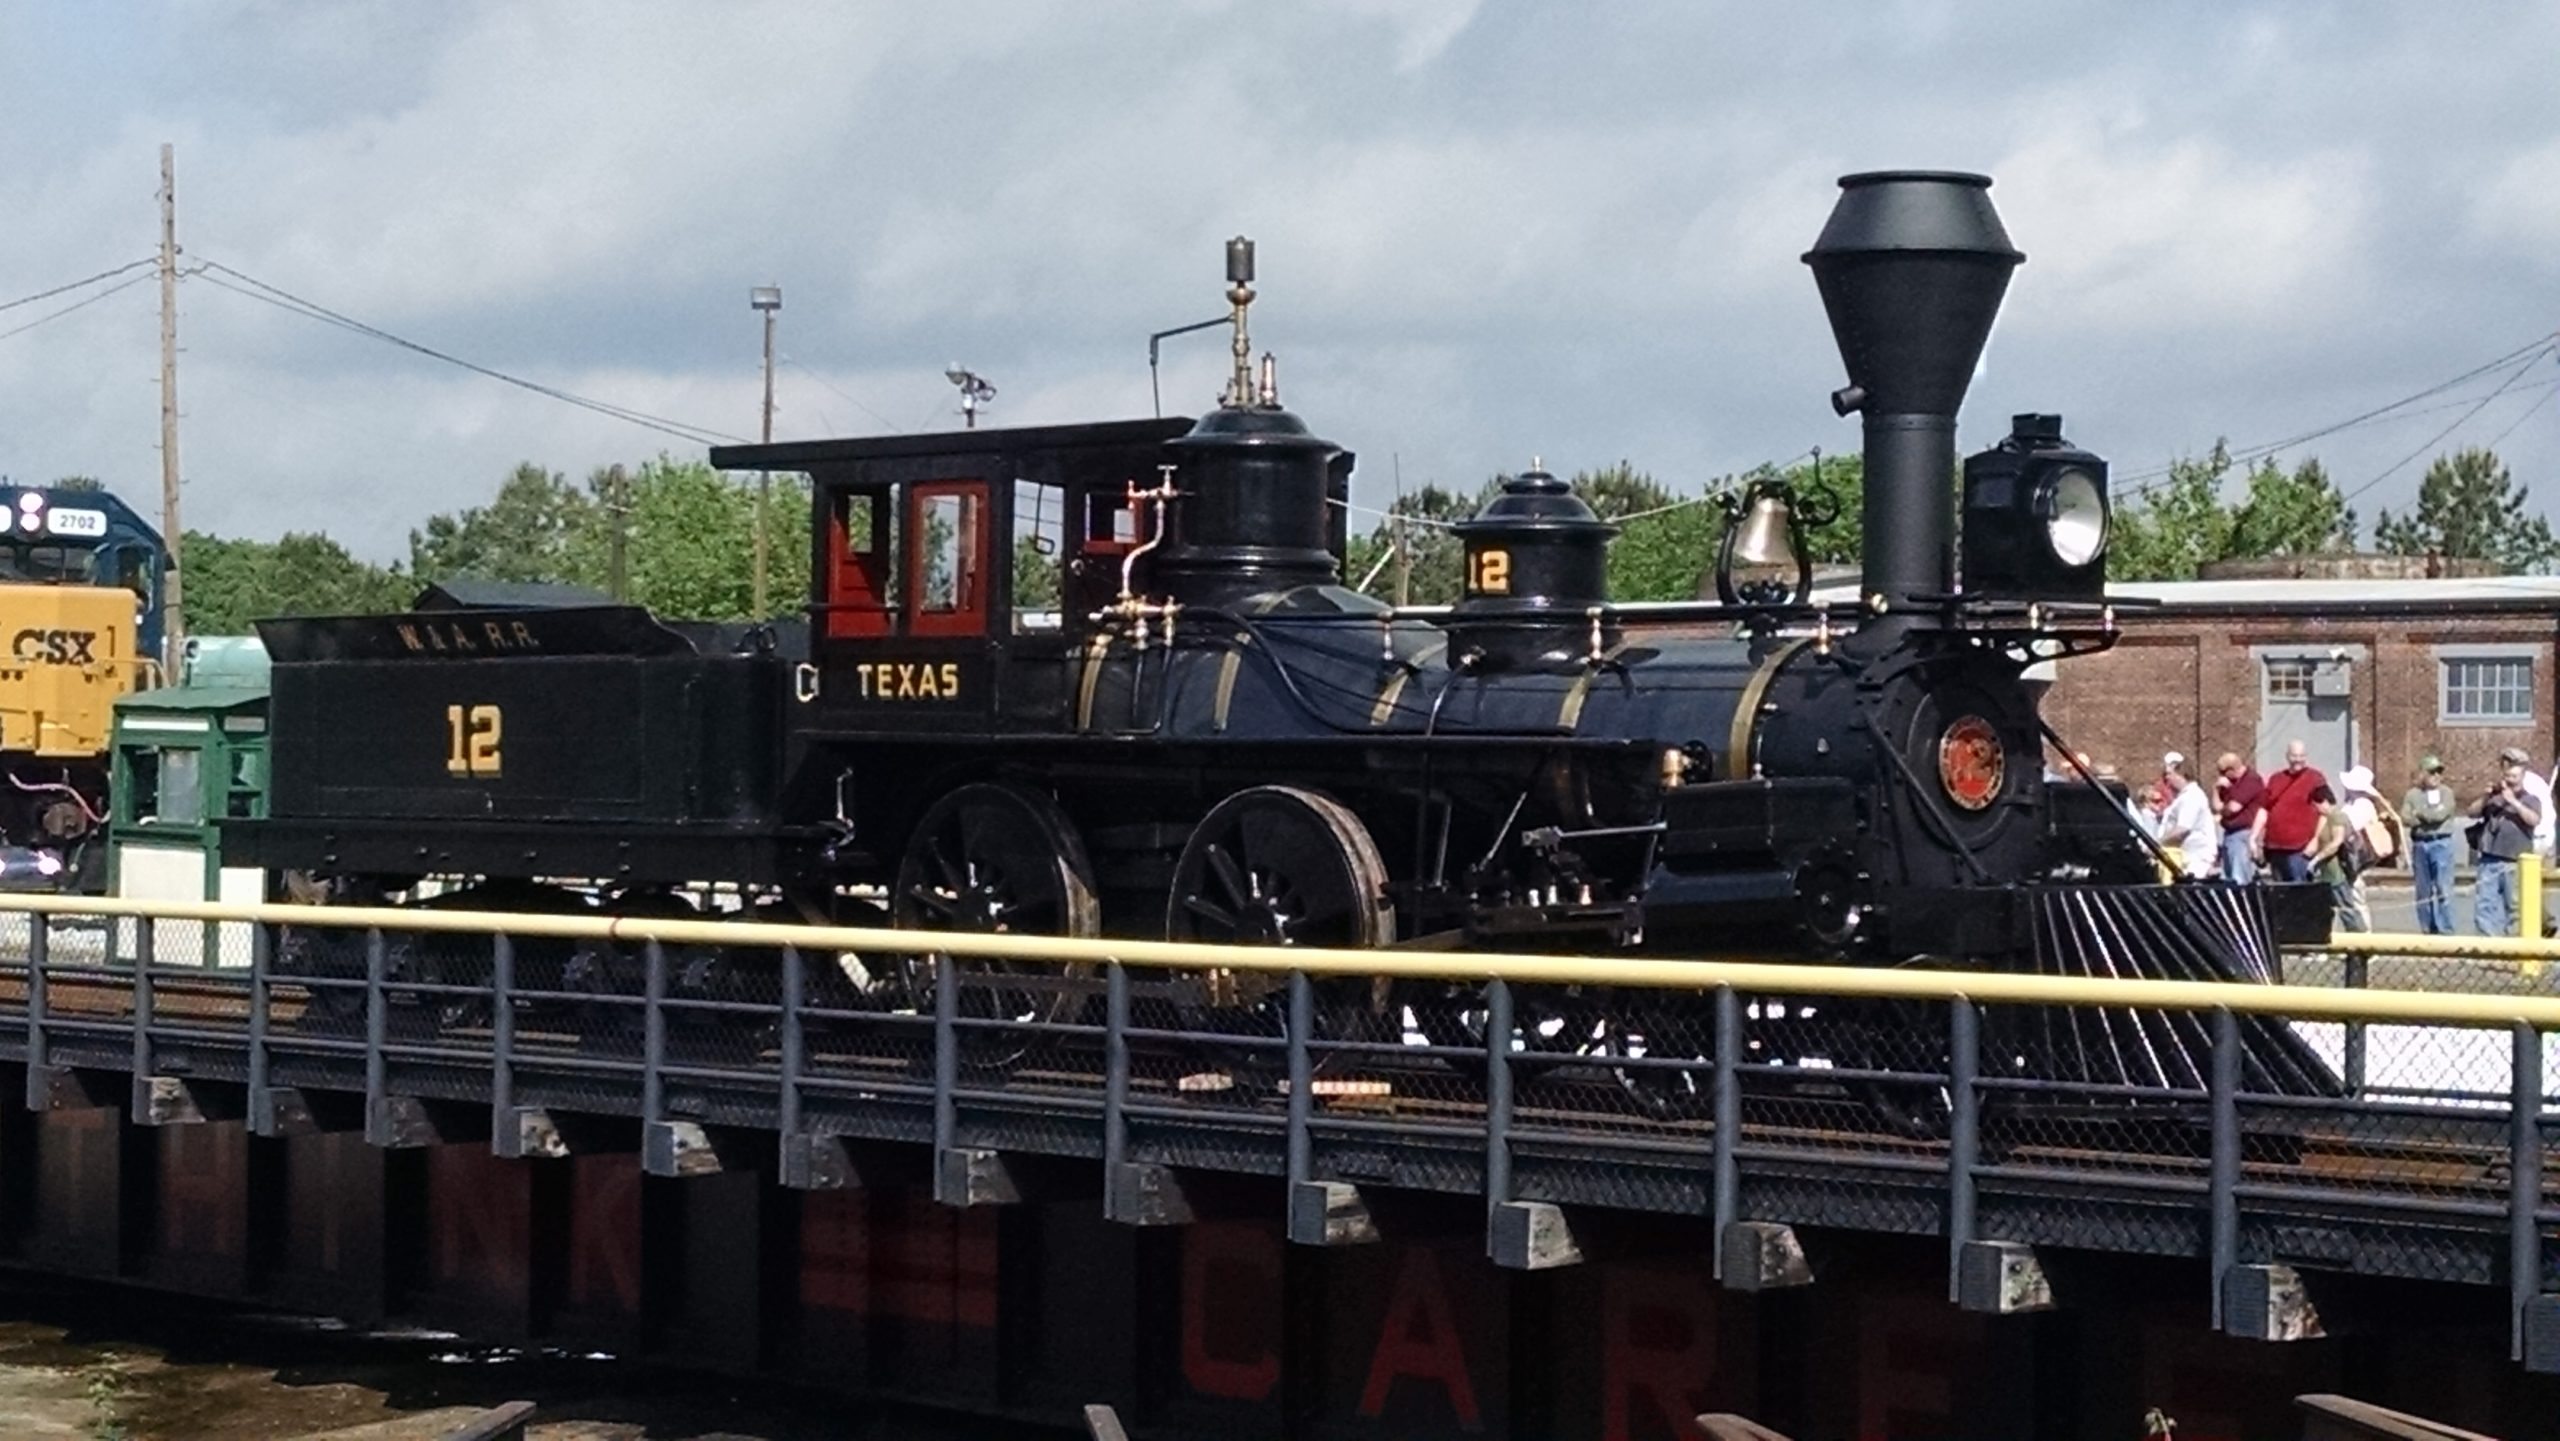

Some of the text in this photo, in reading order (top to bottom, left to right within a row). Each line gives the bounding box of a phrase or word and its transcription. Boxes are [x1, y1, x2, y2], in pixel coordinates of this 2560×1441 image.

[60, 514, 96, 530] 2702
[1468, 550, 1510, 594] 12
[13, 629, 96, 665] CSX
[856, 663, 959, 699] TEXAS
[447, 704, 502, 778] 12
